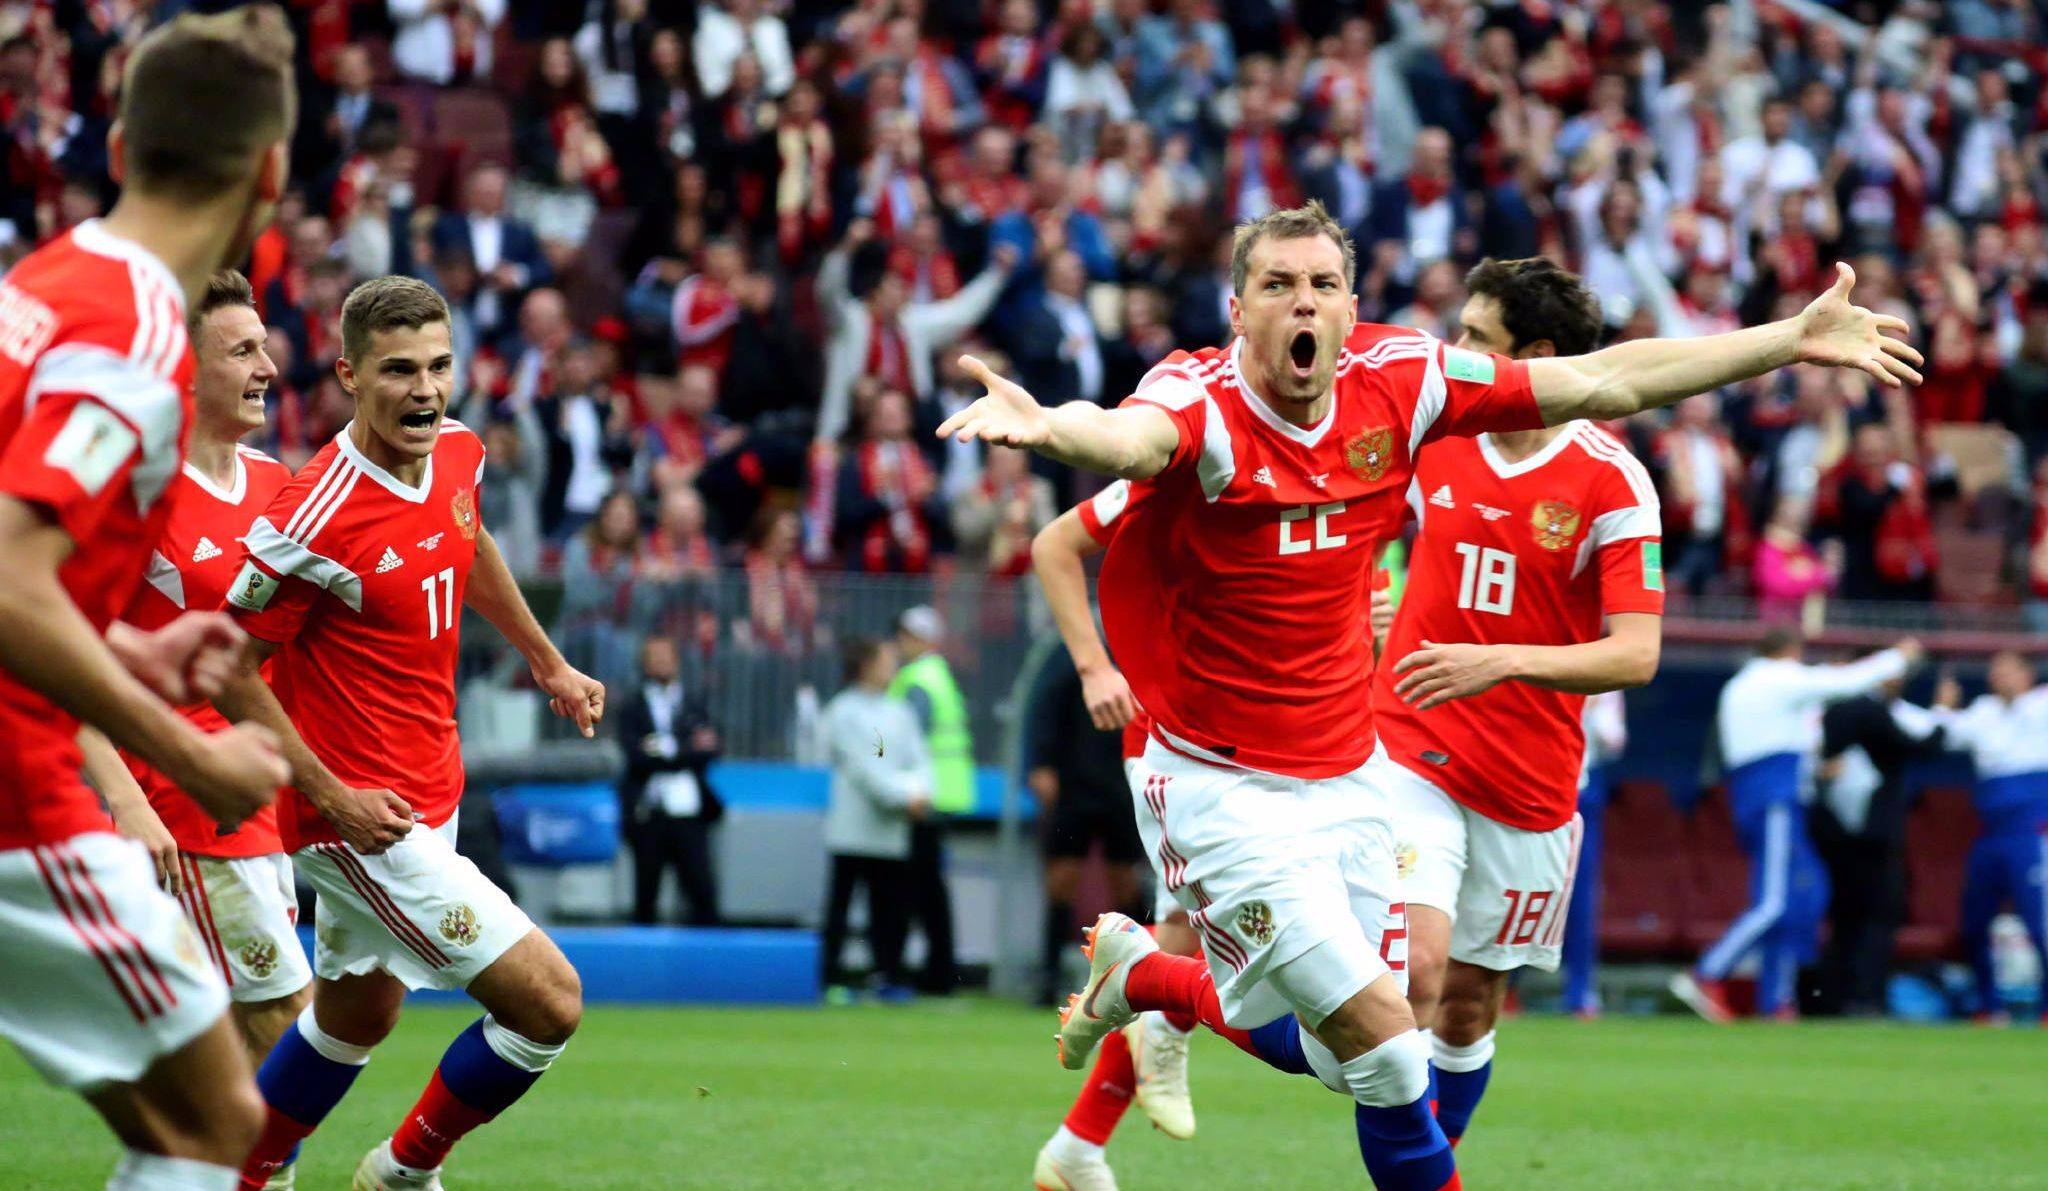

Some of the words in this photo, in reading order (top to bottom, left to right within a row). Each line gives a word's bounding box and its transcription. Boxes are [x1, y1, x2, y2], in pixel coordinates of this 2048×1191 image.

[375, 557, 405, 574] adidas
[1455, 541, 1517, 616] 18
[421, 566, 454, 640] 11
[1495, 889, 1554, 945] 18
